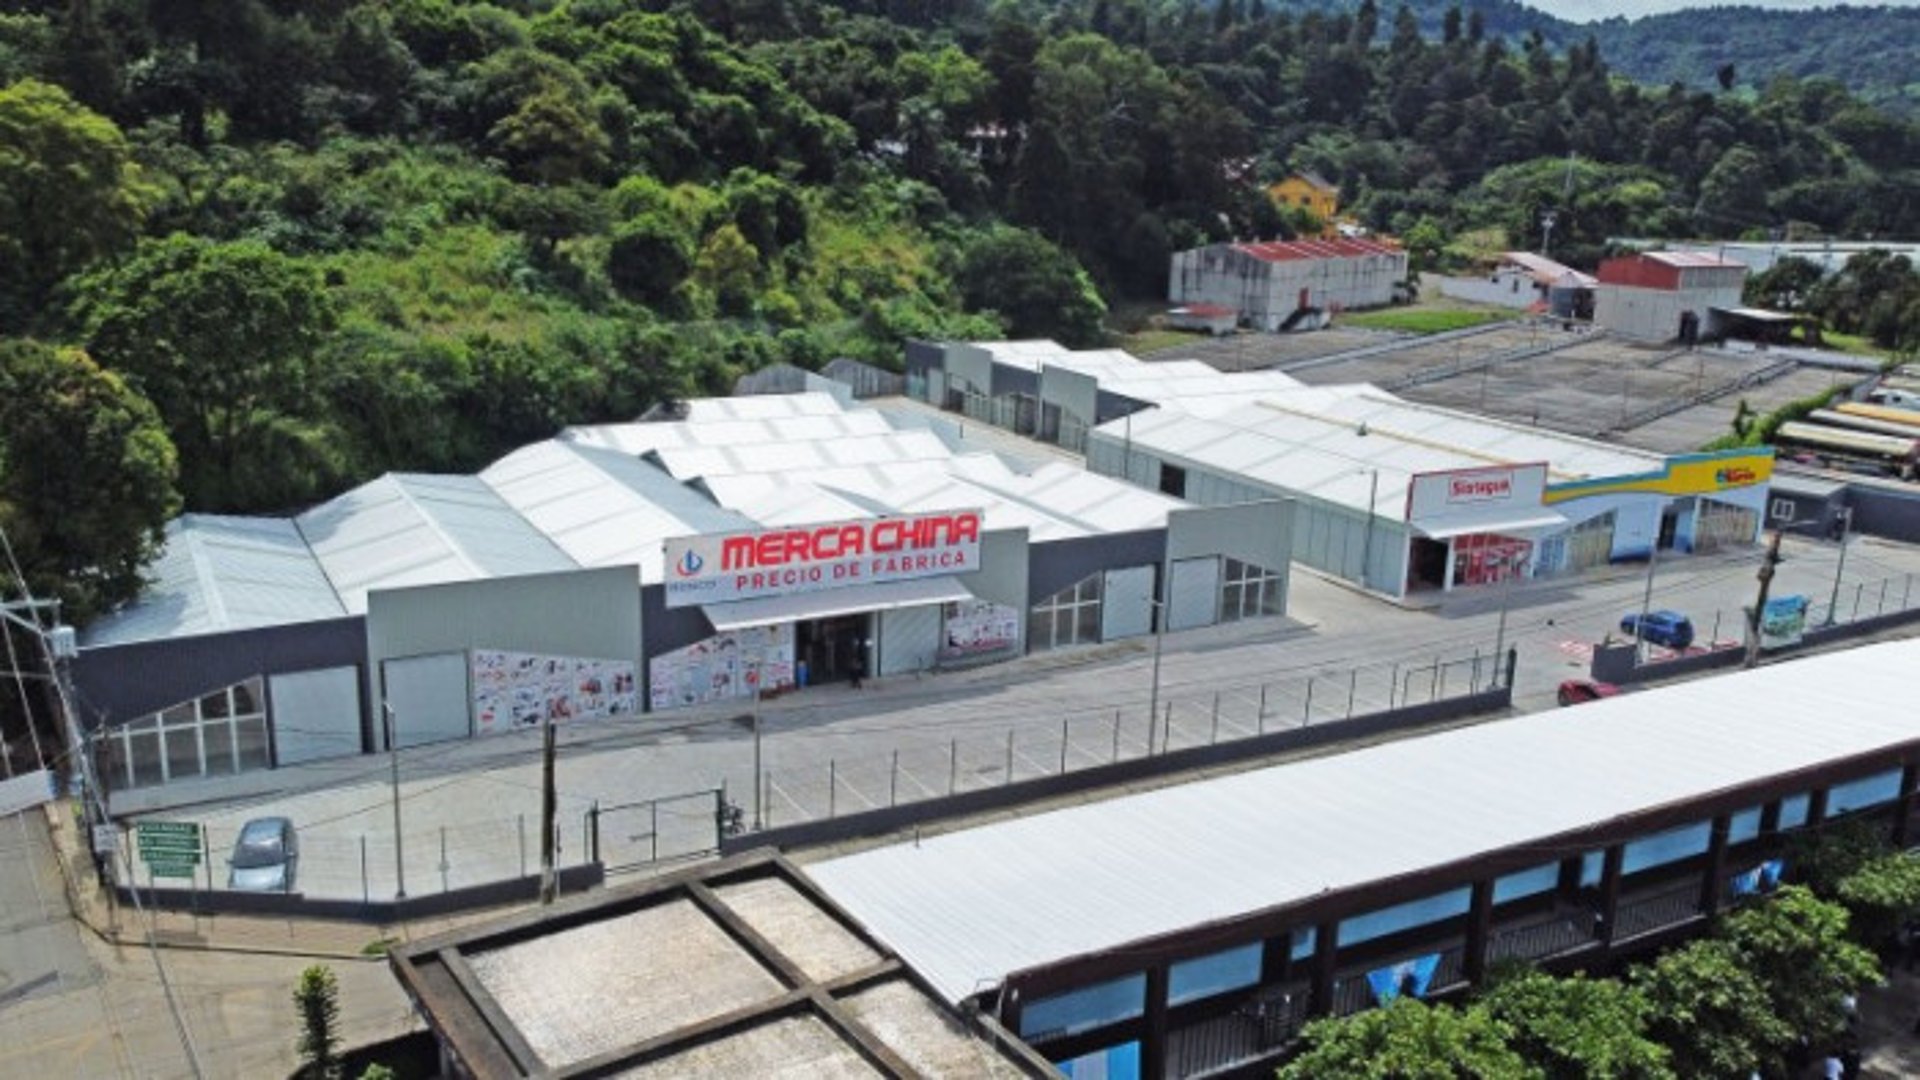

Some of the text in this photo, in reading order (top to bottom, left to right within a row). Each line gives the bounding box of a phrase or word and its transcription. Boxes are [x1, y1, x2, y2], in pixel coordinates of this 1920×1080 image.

[722, 514, 979, 570] MERCA CHINA
[736, 552, 964, 591] PRECIO DE FABRICA
